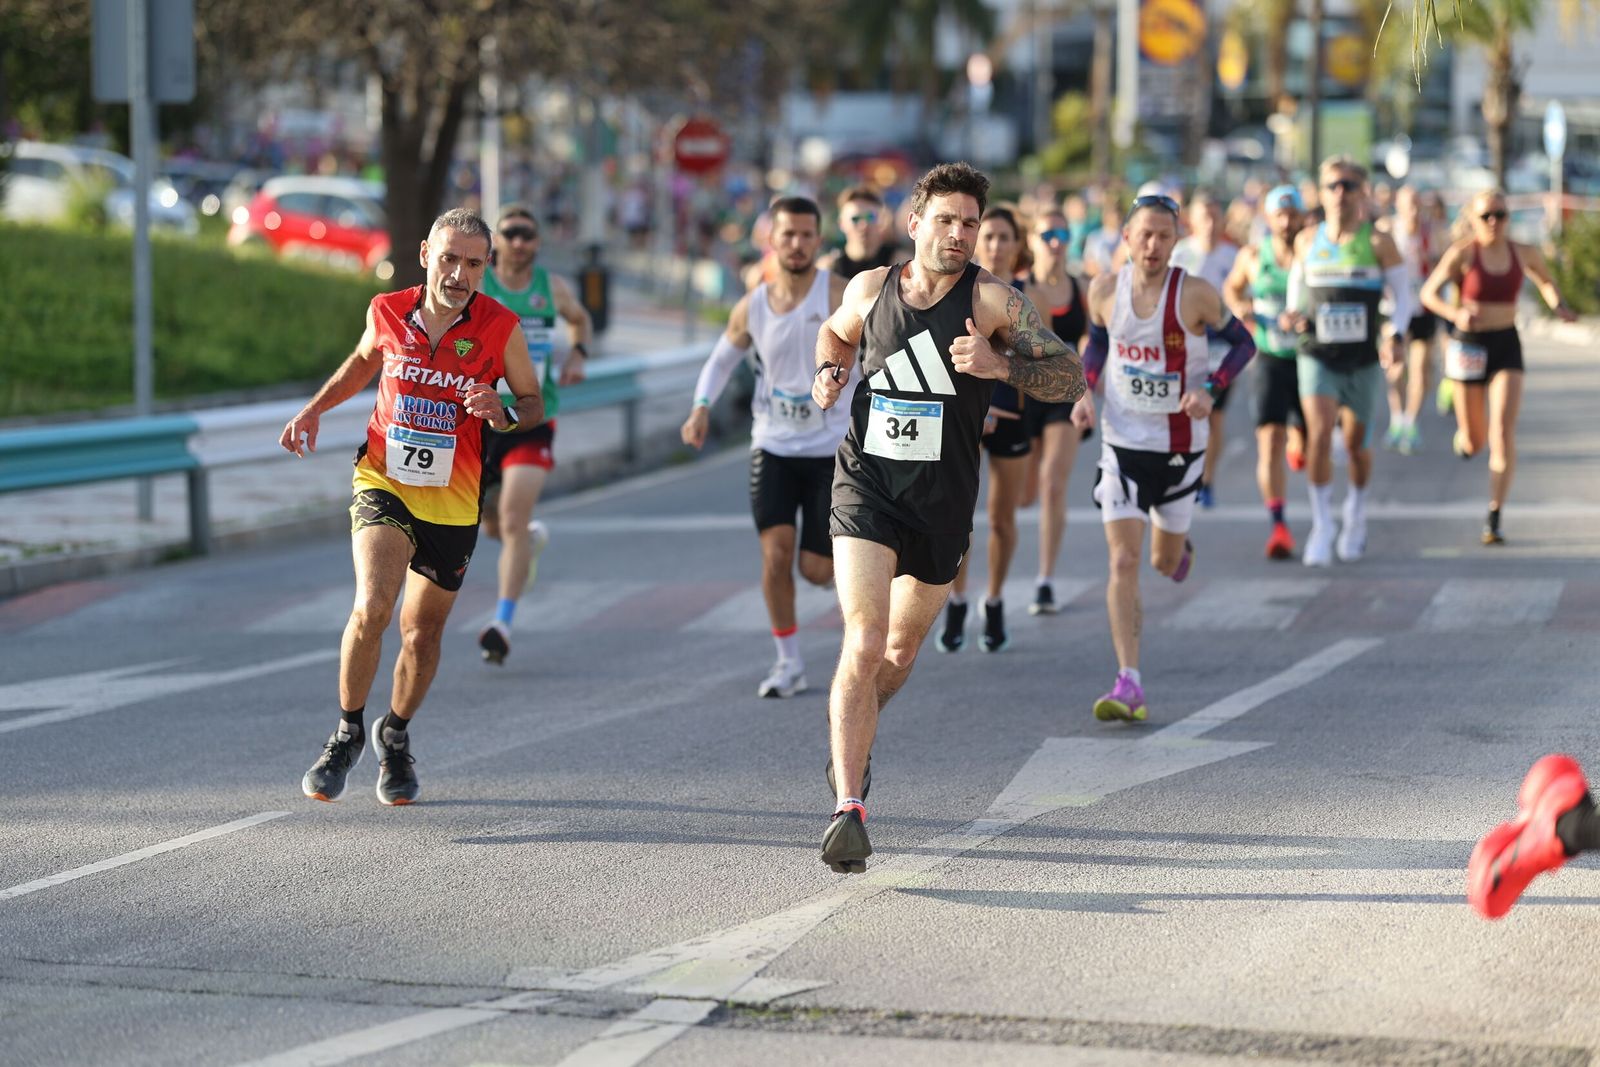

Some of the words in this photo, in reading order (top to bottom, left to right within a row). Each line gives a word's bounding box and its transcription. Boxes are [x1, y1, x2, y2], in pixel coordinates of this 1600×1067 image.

[1131, 378, 1169, 398] 933
[393, 393, 457, 420] ARIDOS
[886, 416, 919, 441] 34
[403, 445, 434, 469] 79
